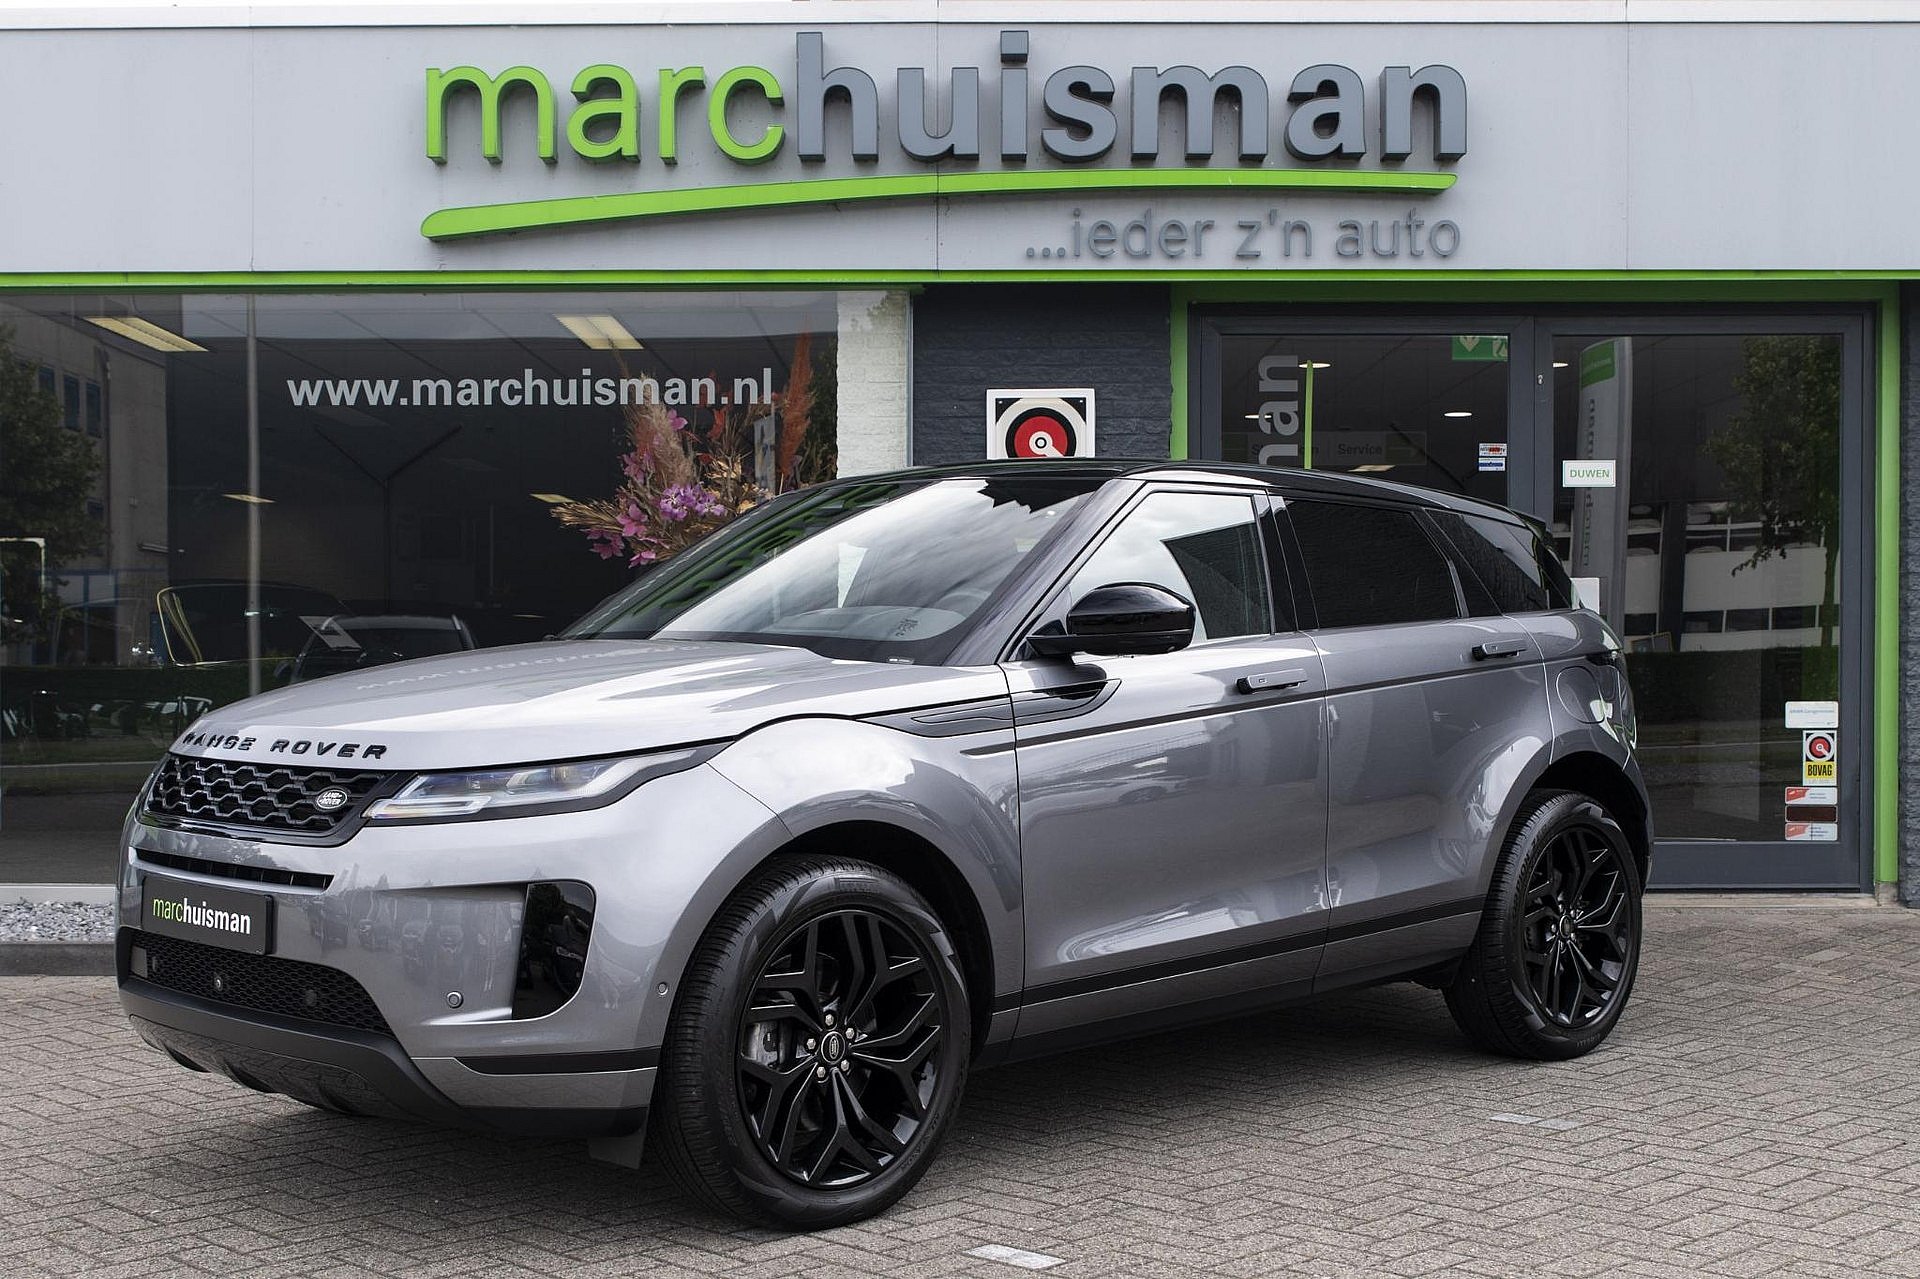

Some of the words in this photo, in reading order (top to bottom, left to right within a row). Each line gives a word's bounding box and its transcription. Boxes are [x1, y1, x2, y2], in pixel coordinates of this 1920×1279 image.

[425, 31, 1467, 164] marchuisman
[1237, 208, 1313, 258] z'n
[1336, 208, 1462, 258] auto
[287, 368, 772, 406] www.marchuisman.nl
[1338, 443, 1383, 456] Service
[1569, 469, 1610, 479] DUWEN
[183, 731, 257, 751] RANGE
[269, 738, 388, 760] ROVER
[1807, 764, 1833, 776] BOVAG
[153, 897, 251, 935] marchuisman
